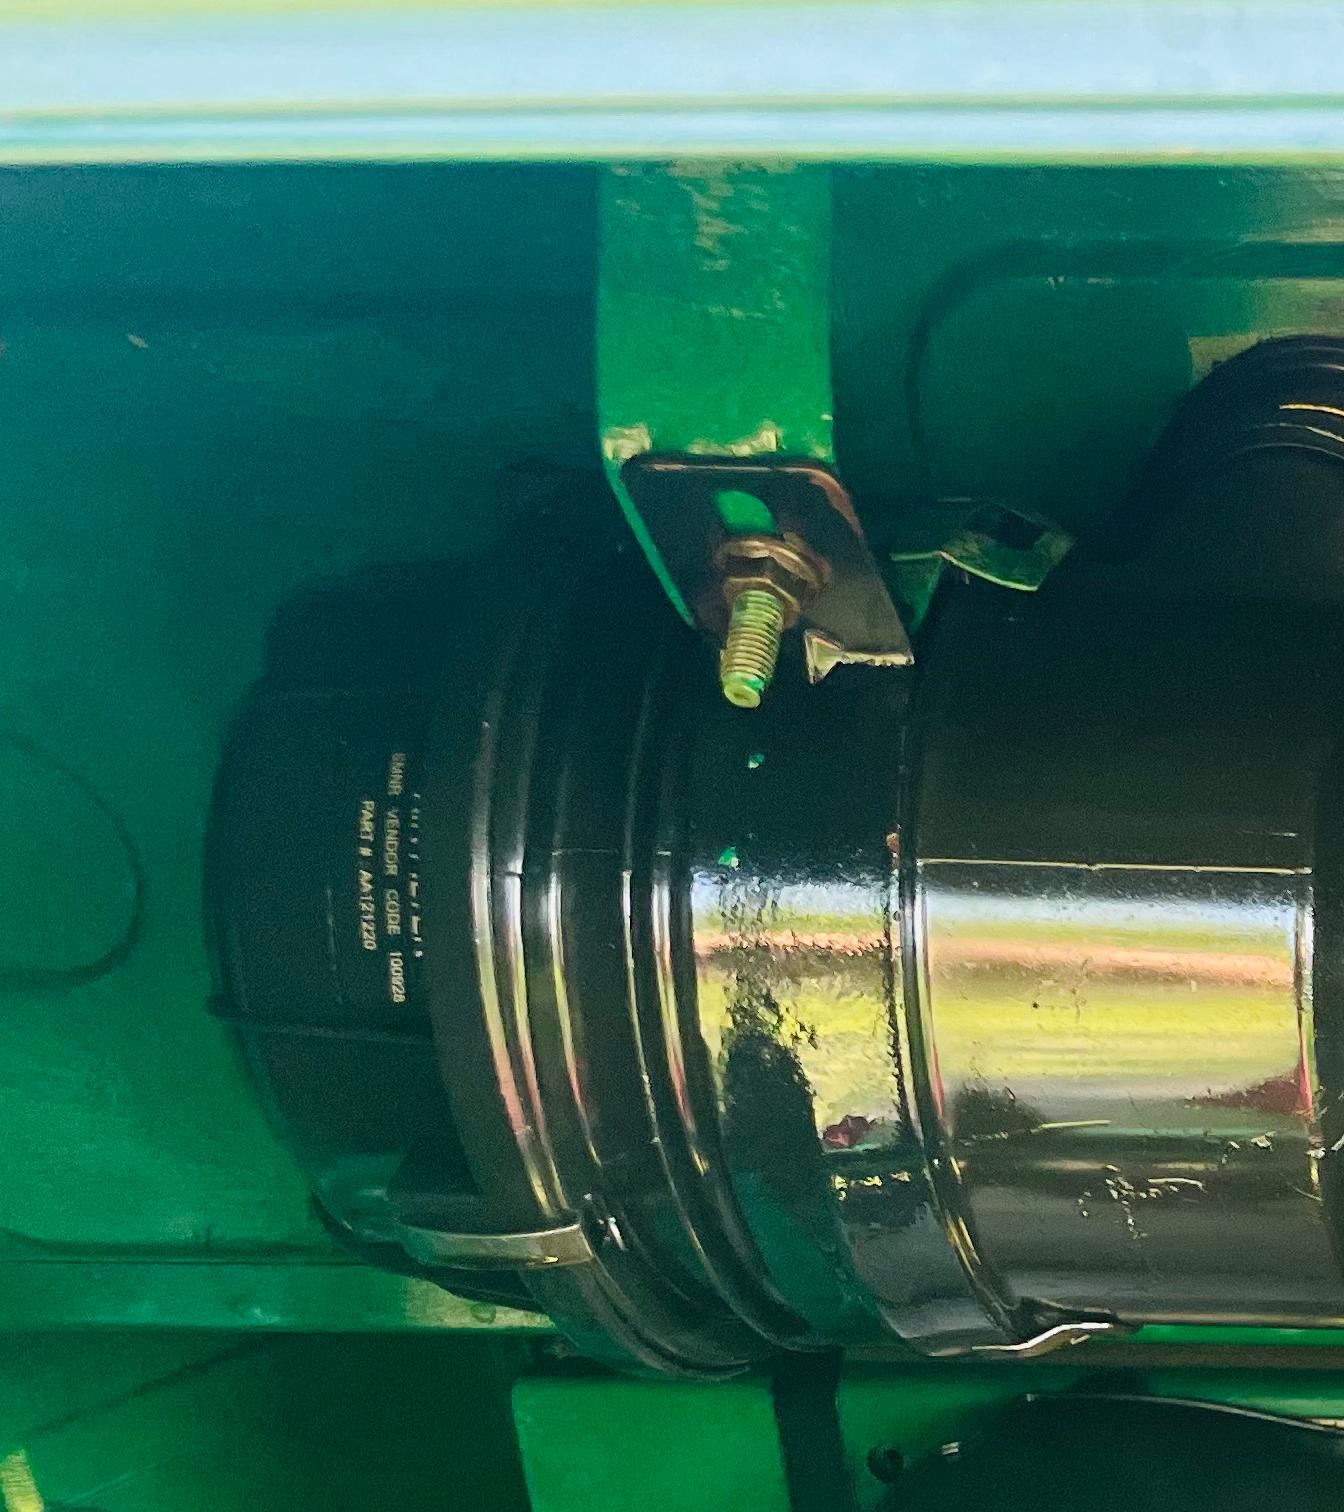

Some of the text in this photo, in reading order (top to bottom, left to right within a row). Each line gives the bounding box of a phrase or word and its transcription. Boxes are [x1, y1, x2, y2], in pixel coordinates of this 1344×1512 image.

[359, 800, 375, 841] PART
[384, 809, 399, 876] VENDOR
[359, 869, 376, 950] AA121220
[384, 888, 401, 935] CODE
